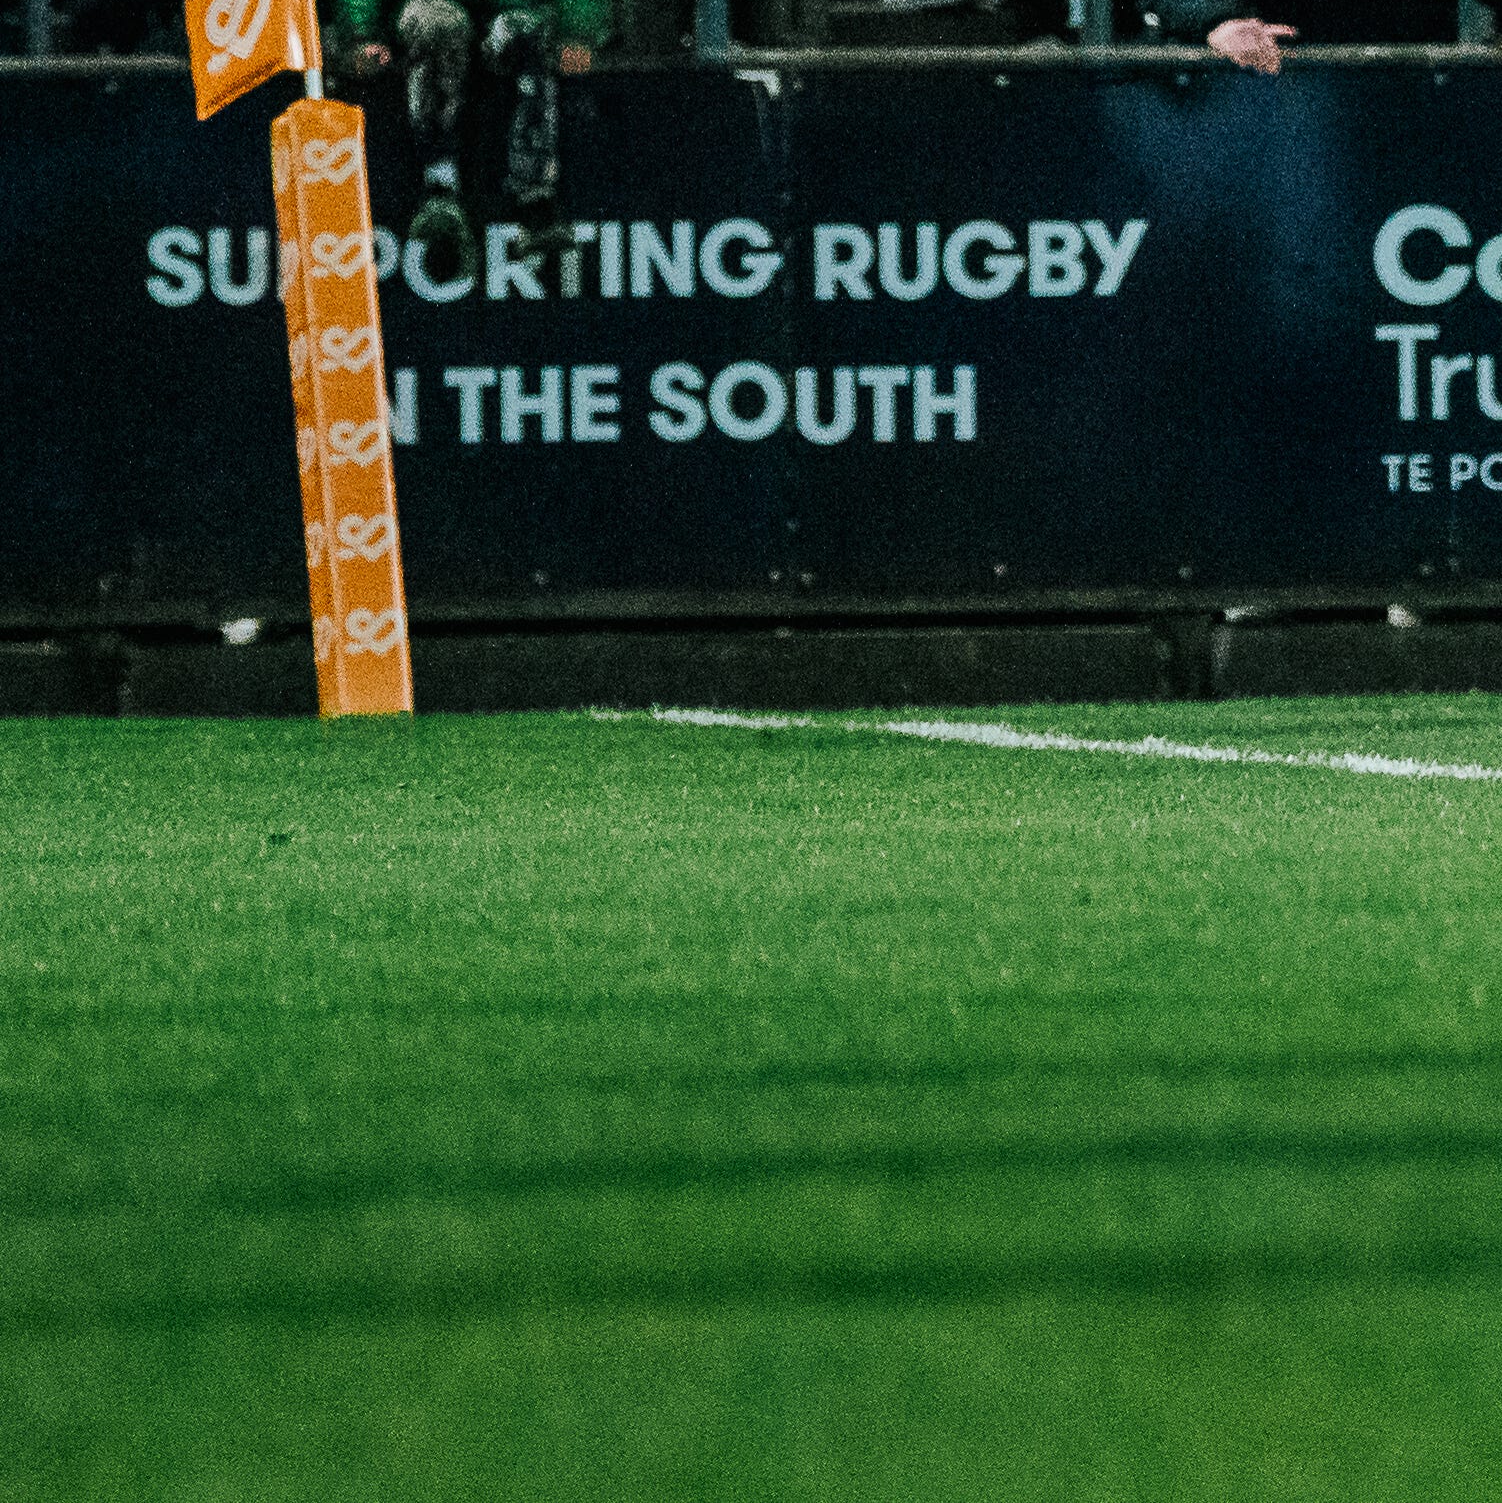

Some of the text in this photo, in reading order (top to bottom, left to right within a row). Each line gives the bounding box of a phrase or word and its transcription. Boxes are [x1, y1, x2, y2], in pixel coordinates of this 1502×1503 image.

[812, 218, 1149, 302] RUGBY
[443, 365, 622, 444] THE
[648, 361, 978, 446] SOUTH
[1381, 453, 1432, 493] TE
